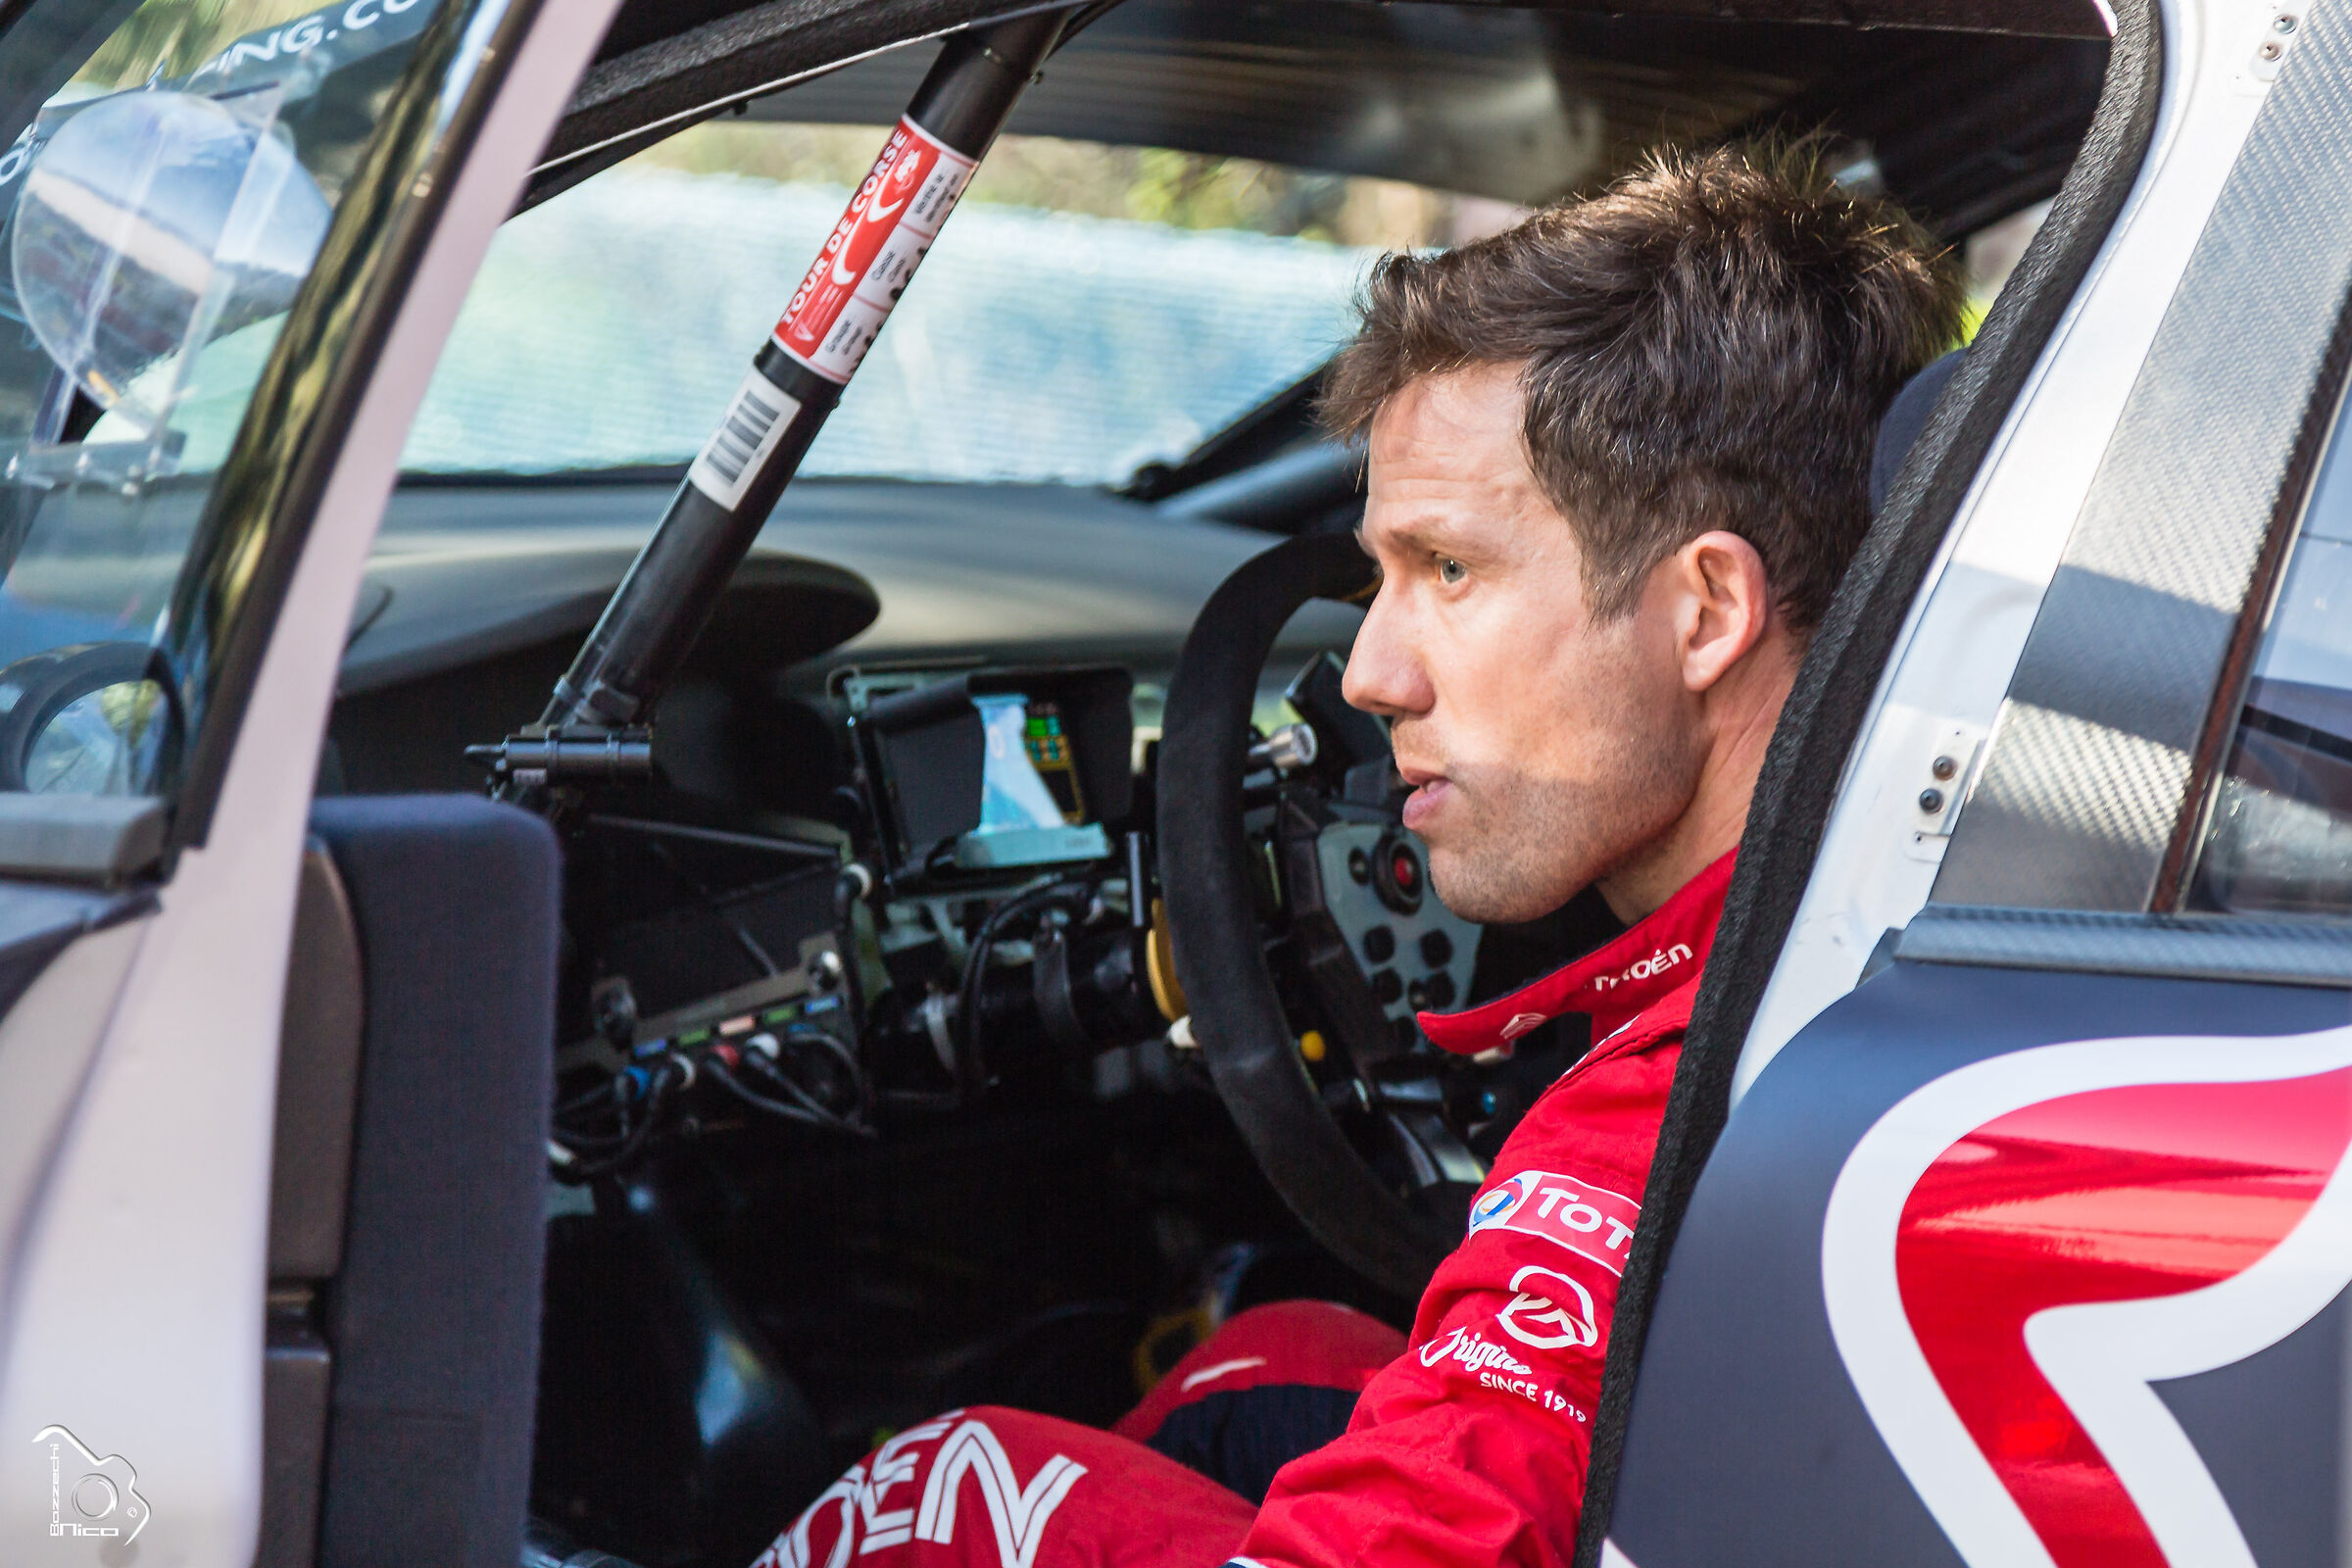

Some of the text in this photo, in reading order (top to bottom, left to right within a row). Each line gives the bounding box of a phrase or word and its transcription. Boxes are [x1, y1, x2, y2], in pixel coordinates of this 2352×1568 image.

[782, 257, 828, 324] TOUR
[826, 218, 854, 254] DE
[852, 129, 907, 214] CORSE
[1538, 1187, 1636, 1260] TOT
[1479, 1372, 1539, 1402] SINCE
